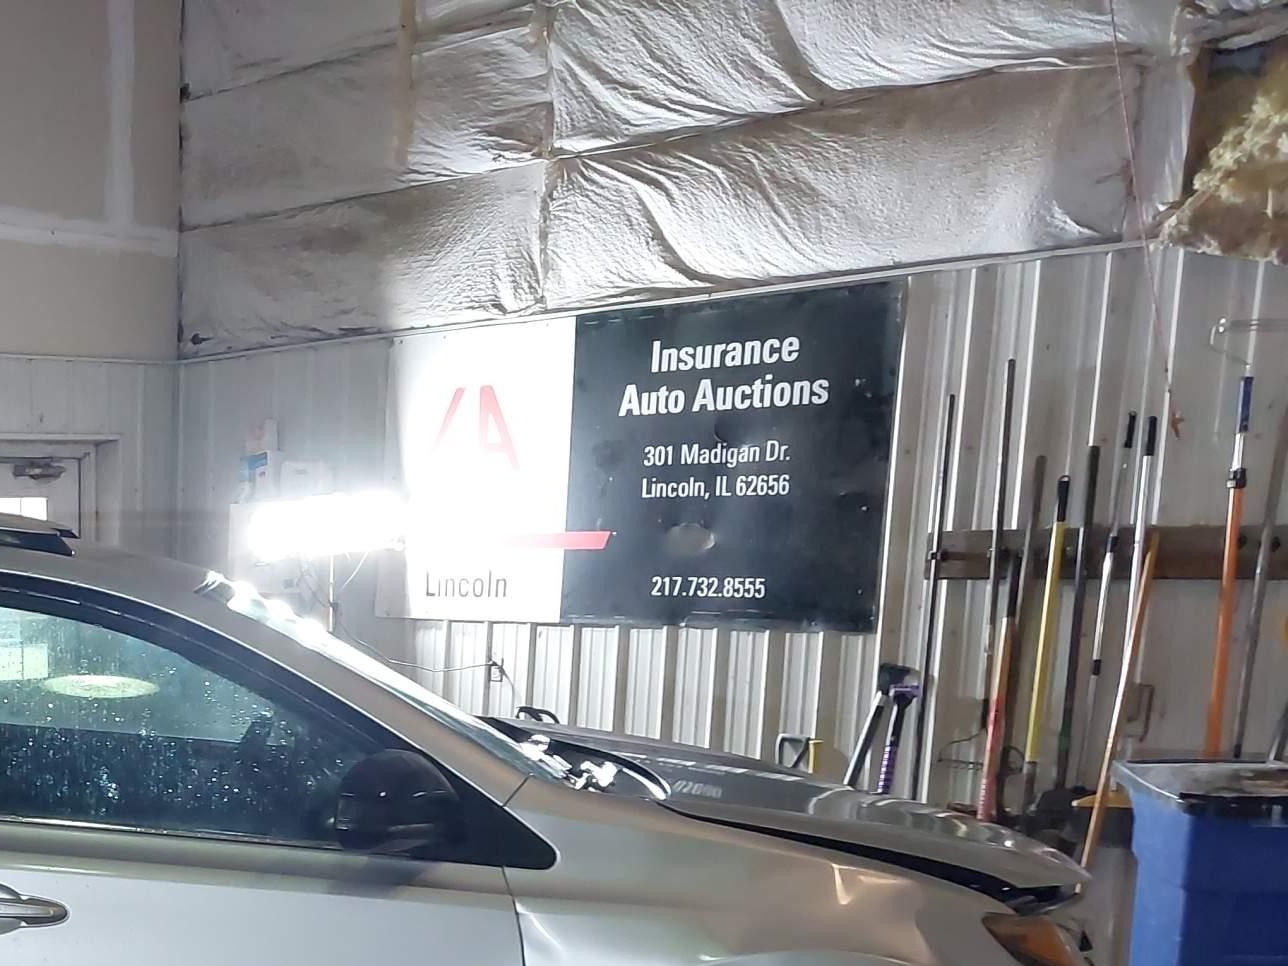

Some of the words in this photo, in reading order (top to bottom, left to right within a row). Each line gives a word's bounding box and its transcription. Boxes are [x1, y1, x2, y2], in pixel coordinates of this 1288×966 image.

[651, 336, 801, 373] Insurance
[618, 383, 685, 417] Auto
[691, 374, 830, 412] Auctions
[643, 445, 674, 467] 301
[680, 442, 761, 468] Madigan
[765, 440, 791, 462] Dr.
[641, 477, 711, 500] Lincoln,
[715, 476, 732, 497] IL
[735, 474, 791, 497] 62656
[424, 570, 508, 598] Lincoln
[650, 576, 766, 599] 217.732.8555
